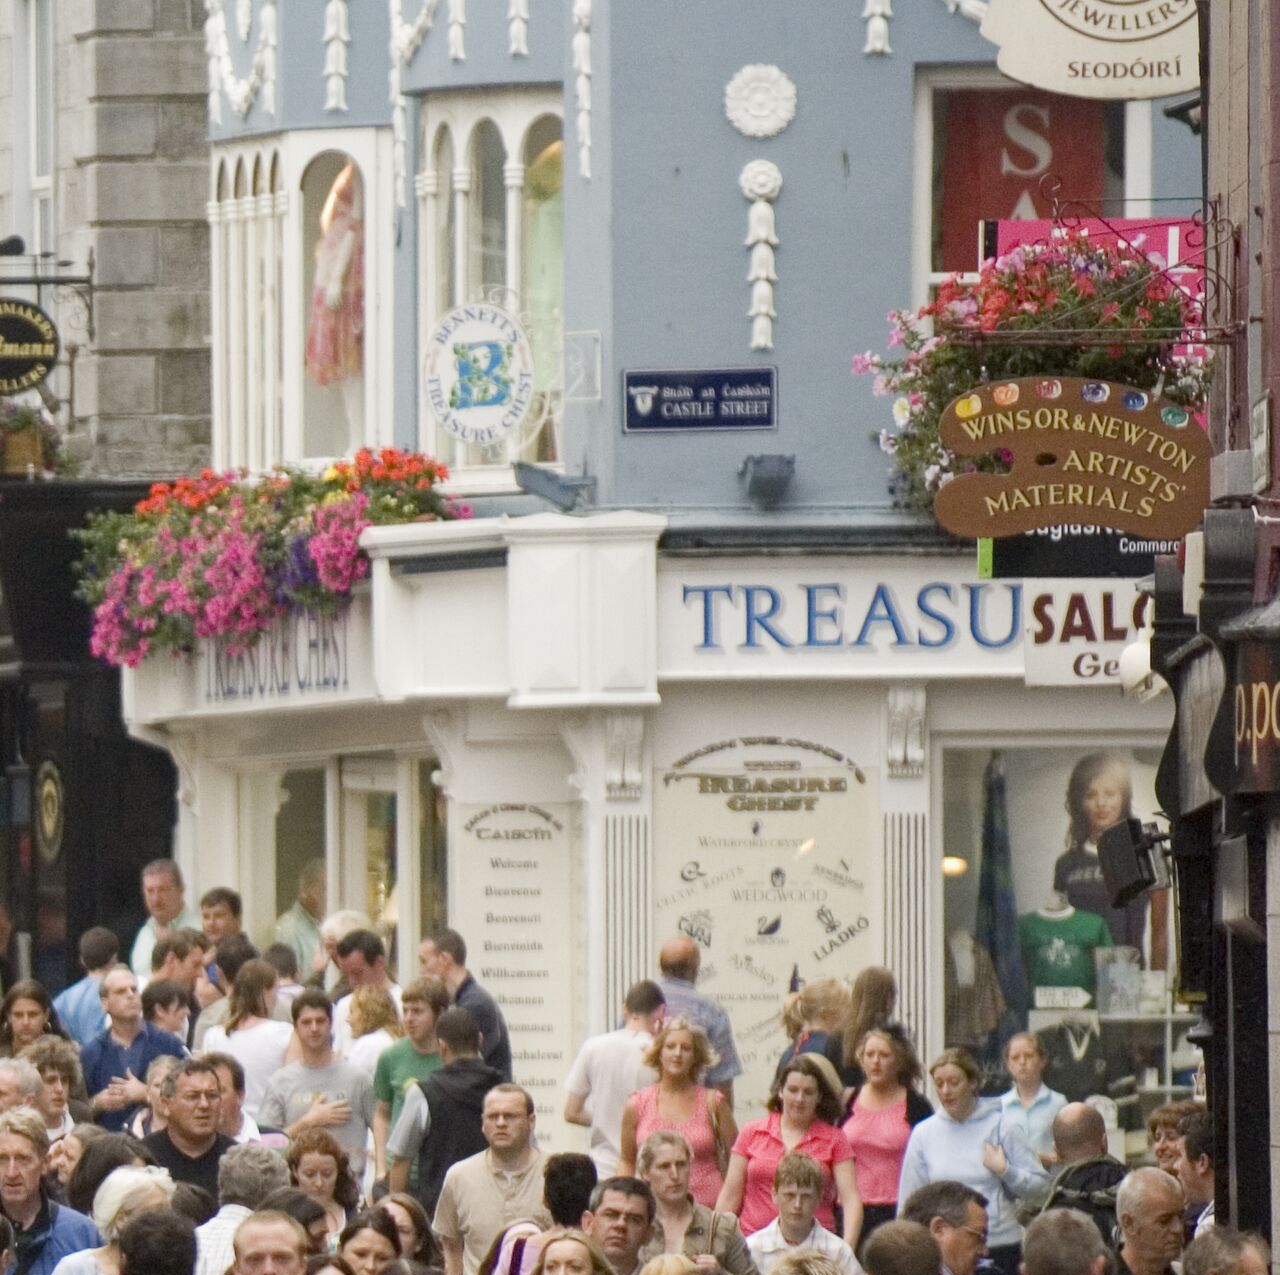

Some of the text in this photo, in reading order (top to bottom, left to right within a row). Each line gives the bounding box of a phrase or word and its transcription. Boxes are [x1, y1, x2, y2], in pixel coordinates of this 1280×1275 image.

[1067, 54, 1182, 79] SEODÓIRÍ
[661, 400, 770, 418] CASTLE STREET
[961, 408, 1070, 441] WINSOR
[1088, 412, 1196, 474] NEWTON
[1062, 449, 1187, 503] ARTISTS'
[984, 484, 1157, 518] MATERIALS
[698, 775, 848, 793] TREASURE
[725, 795, 821, 812] CHEST
[731, 887, 829, 902] WEDGWOOD
